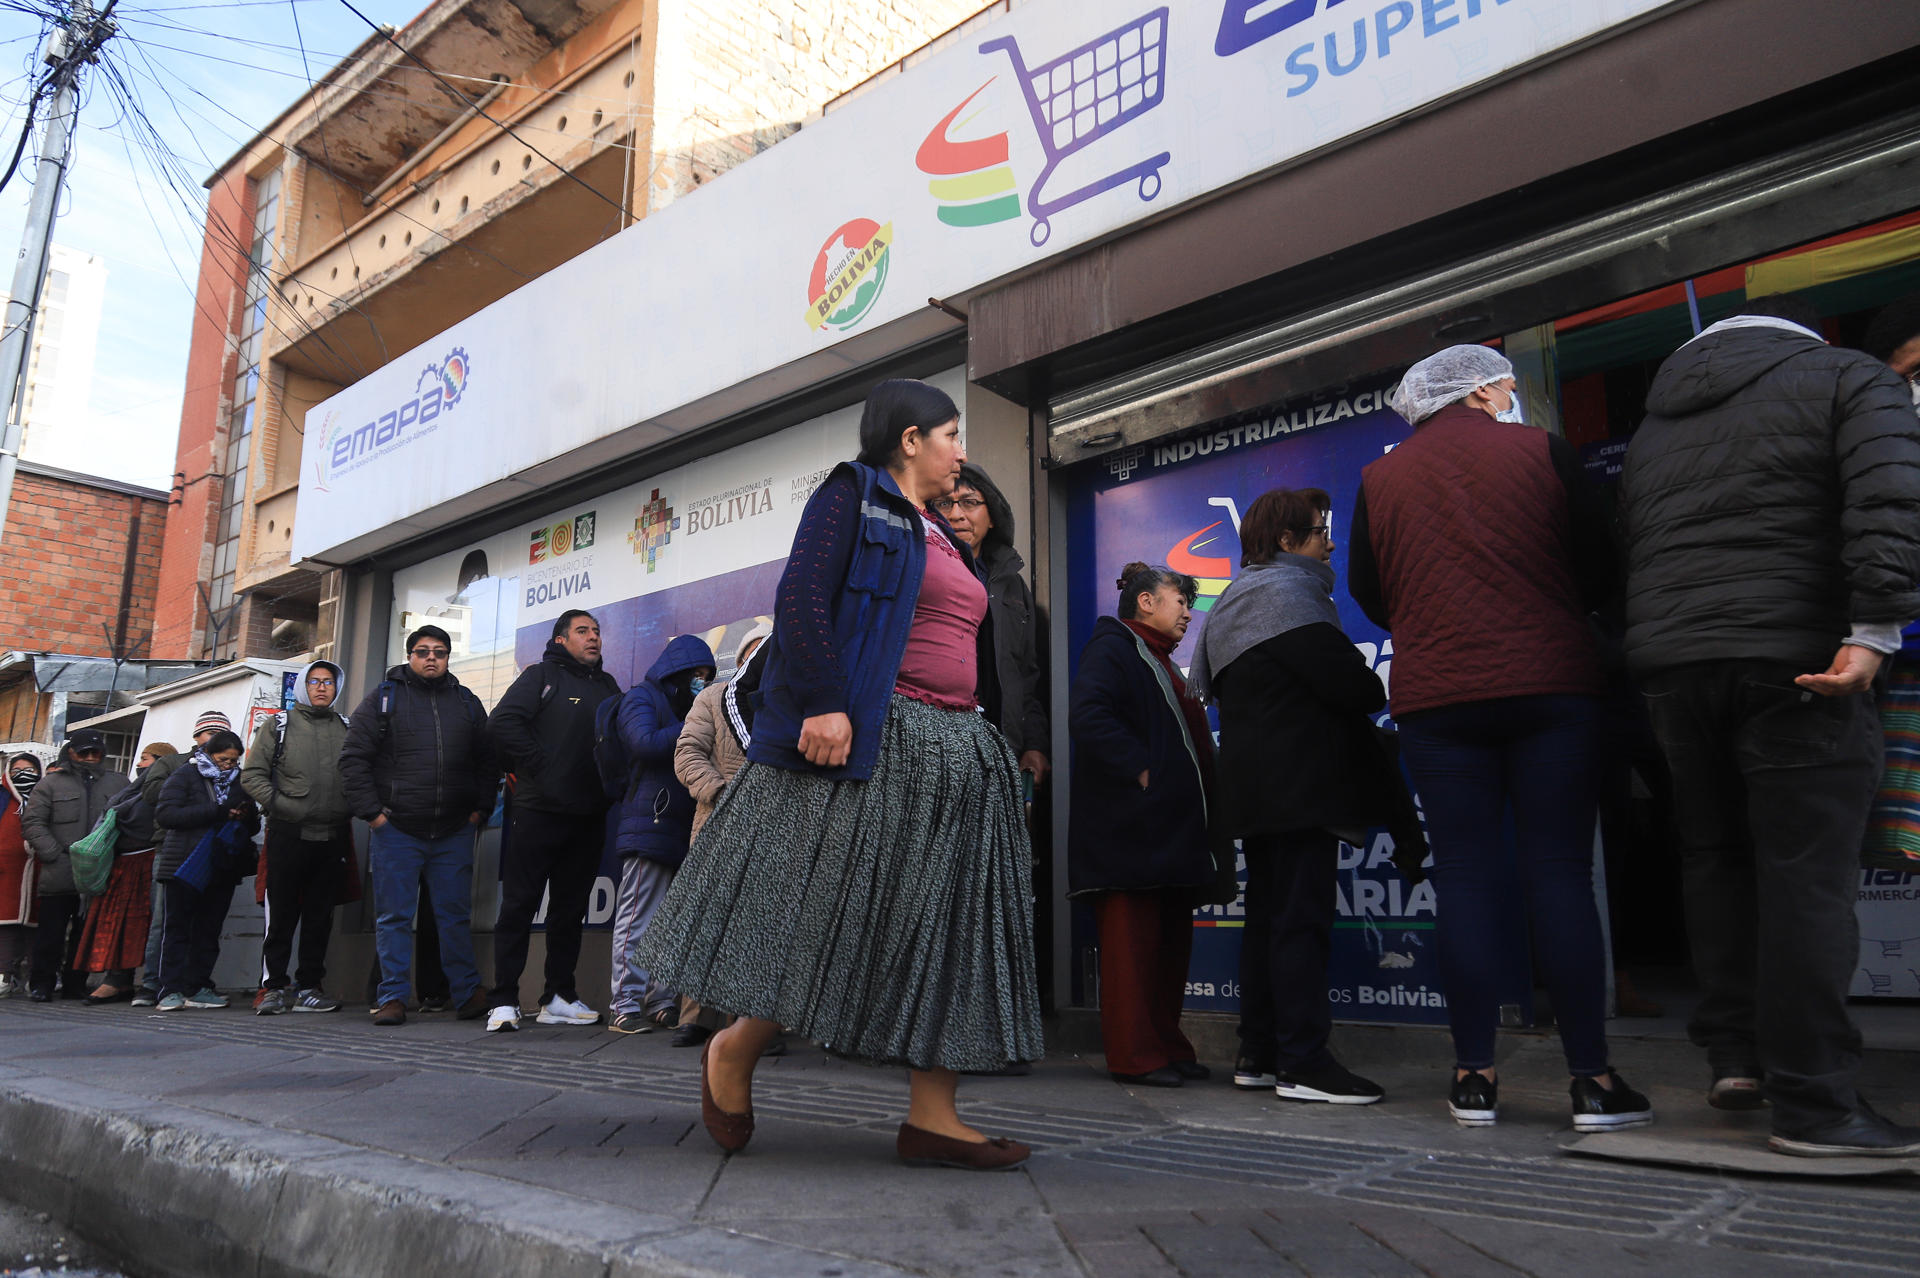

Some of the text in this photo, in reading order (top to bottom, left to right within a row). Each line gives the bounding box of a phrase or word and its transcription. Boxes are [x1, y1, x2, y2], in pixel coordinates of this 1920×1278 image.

[817, 238, 886, 318] BOLIVIA
[826, 247, 857, 286] HECHO EN
[331, 386, 443, 469] emapa
[688, 477, 773, 511] ESTADO PLURINACIONAL DE
[791, 467, 834, 491] MINISTE
[686, 487, 774, 536] BOLIVIA
[527, 554, 593, 586] BICENTENARIO DE
[525, 571, 592, 608] BOLIVIA
